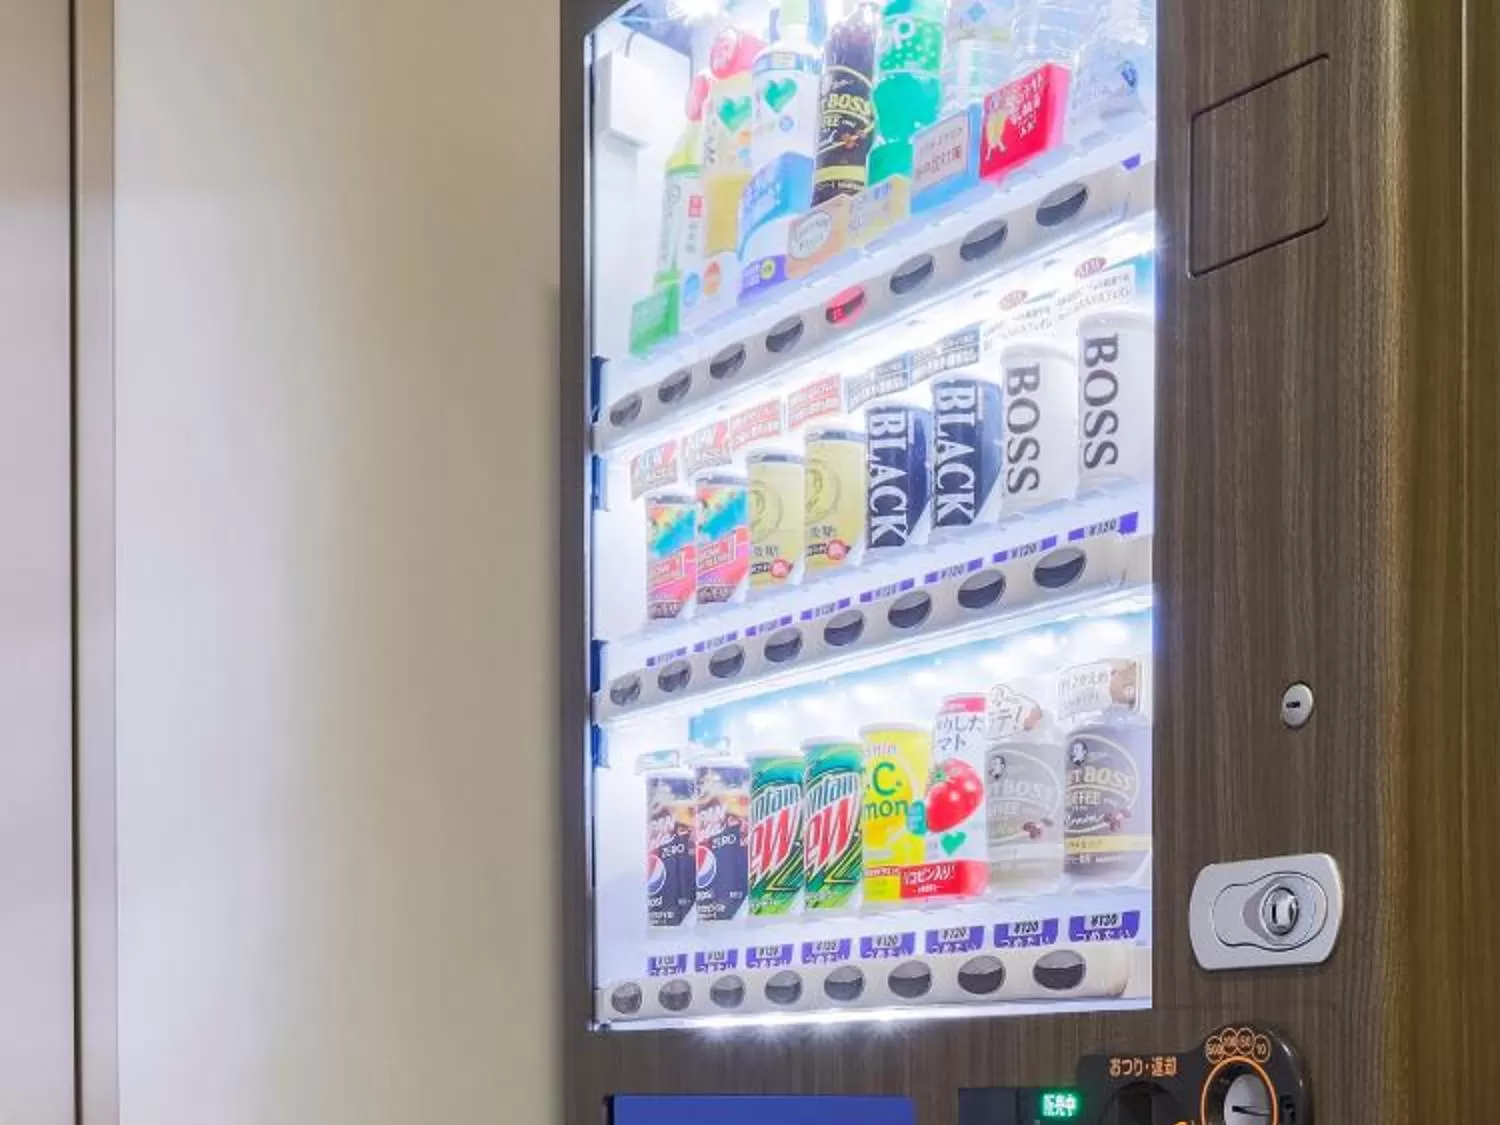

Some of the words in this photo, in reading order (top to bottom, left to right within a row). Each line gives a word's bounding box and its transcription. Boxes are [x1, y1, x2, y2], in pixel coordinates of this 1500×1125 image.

[933, 382, 976, 526] BLACK
[1006, 363, 1041, 496] BOSS
[1083, 332, 1119, 471] BOSS
[867, 407, 909, 548] BLACK
